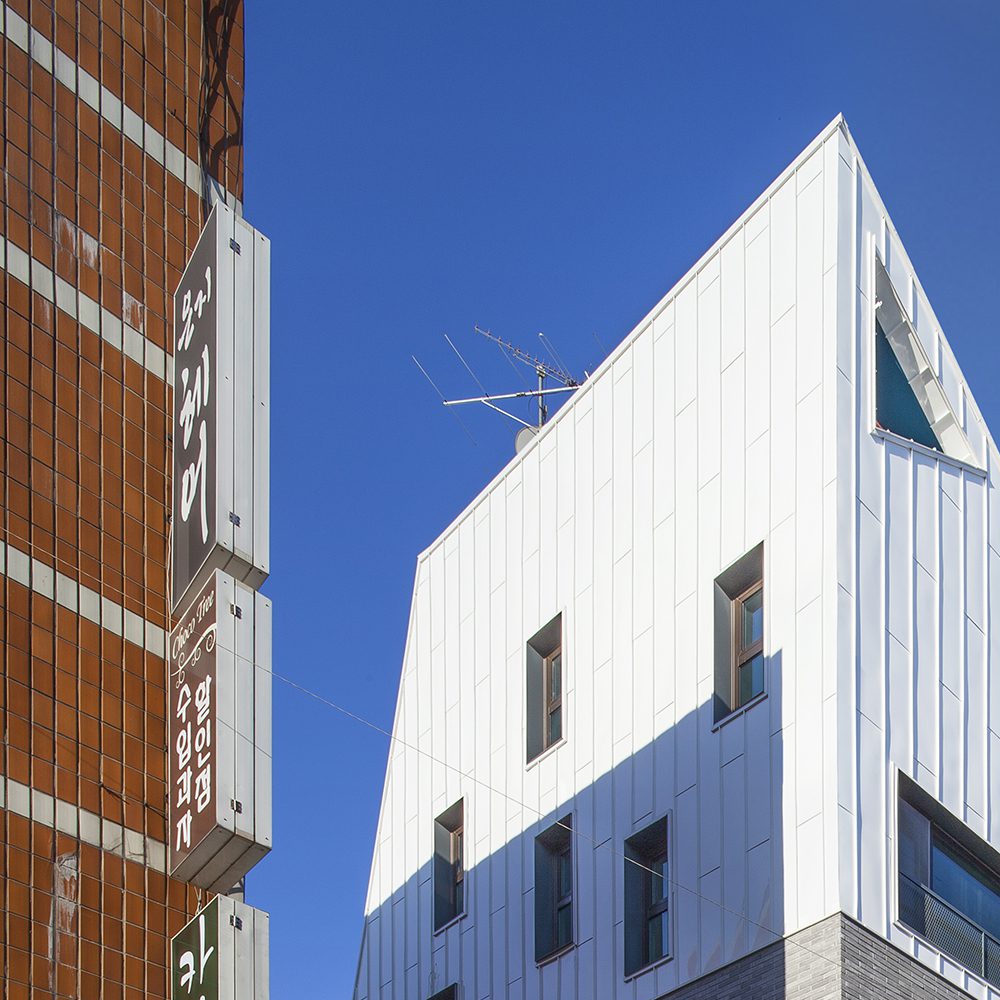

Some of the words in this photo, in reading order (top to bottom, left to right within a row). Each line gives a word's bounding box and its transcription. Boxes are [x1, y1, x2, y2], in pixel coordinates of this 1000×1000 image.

[173, 617, 197, 660] Choco
[196, 590, 214, 623] Tree
[176, 683, 192, 852] 수입과자
[195, 674, 211, 814] 할인점
